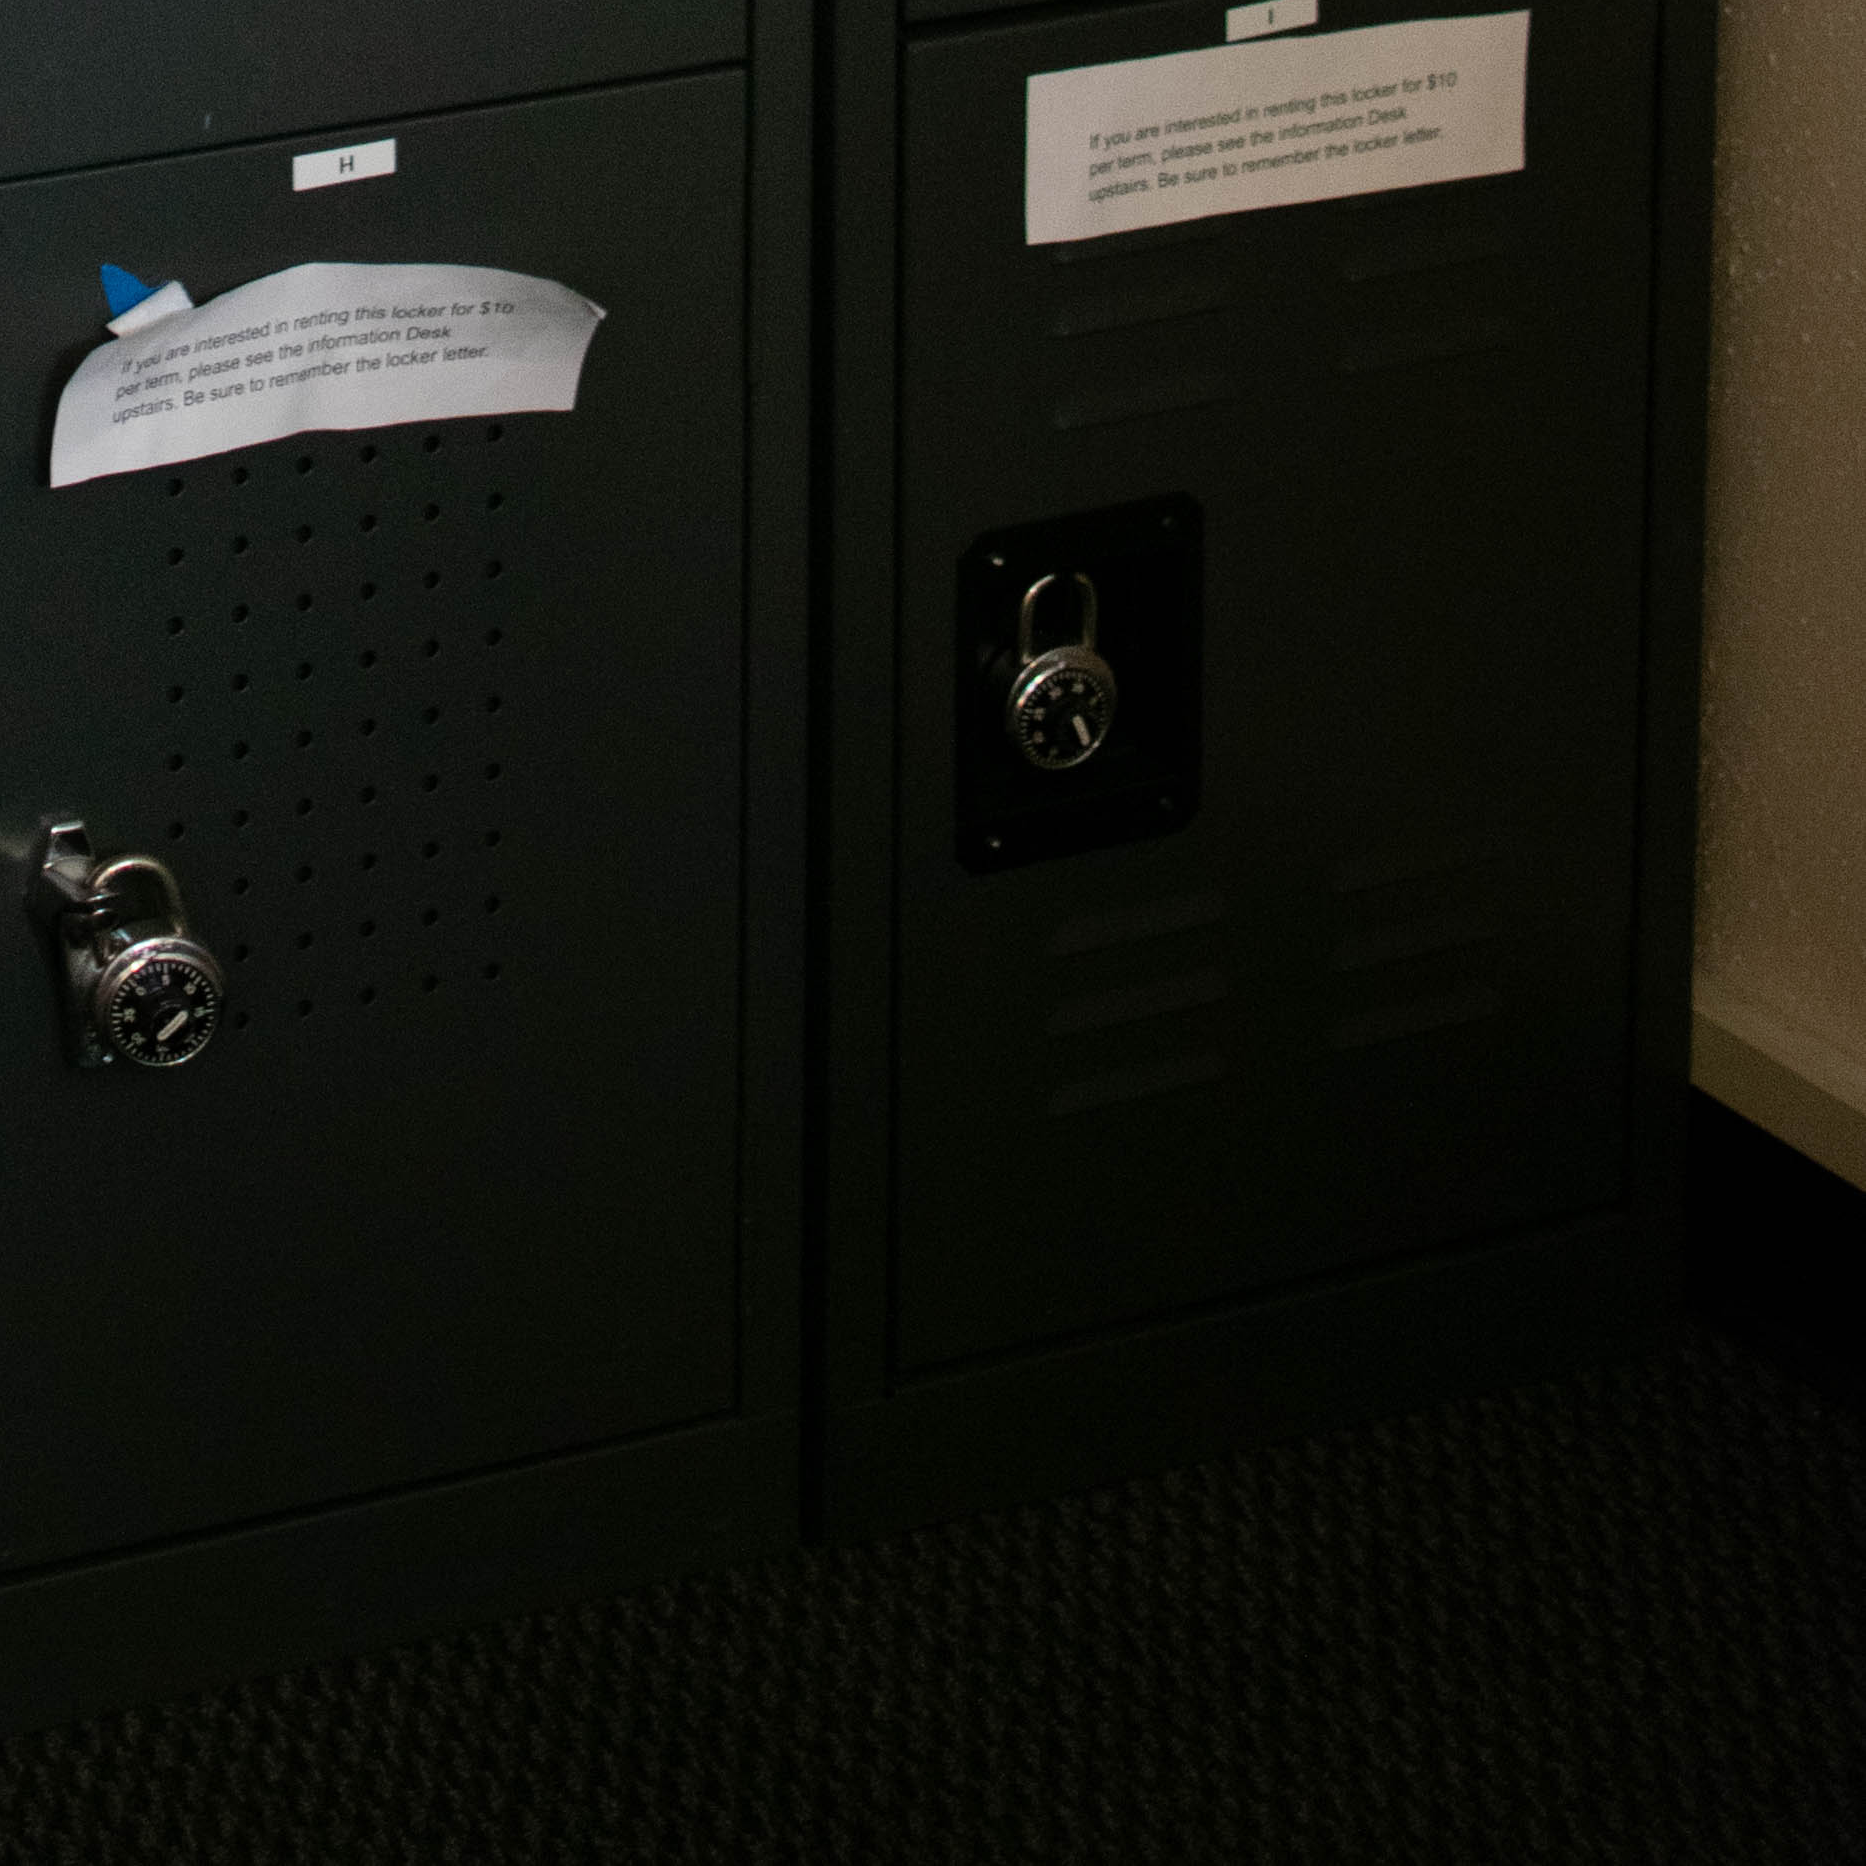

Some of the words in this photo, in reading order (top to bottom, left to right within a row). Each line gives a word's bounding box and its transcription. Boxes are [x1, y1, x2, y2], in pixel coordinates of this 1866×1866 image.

[339, 154, 354, 175] H
[115, 382, 139, 401] per
[187, 358, 240, 385] please
[244, 351, 272, 367] see
[278, 341, 303, 359] the
[405, 323, 452, 340] Desk
[121, 356, 133, 374] If
[136, 353, 161, 373] you
[165, 345, 190, 361] are
[194, 322, 269, 354] interested
[274, 320, 288, 336] in
[294, 311, 349, 332] renting
[354, 304, 385, 323] this
[390, 300, 445, 319] locker
[450, 298, 473, 315] for
[479, 298, 515, 316] $10
[111, 397, 178, 424] upstairs.
[182, 390, 206, 406] Be
[208, 383, 246, 401] sure
[248, 378, 266, 392] to
[268, 360, 351, 388] remember
[355, 353, 382, 371] the
[385, 347, 438, 367] locker
[442, 344, 489, 361] letter.
